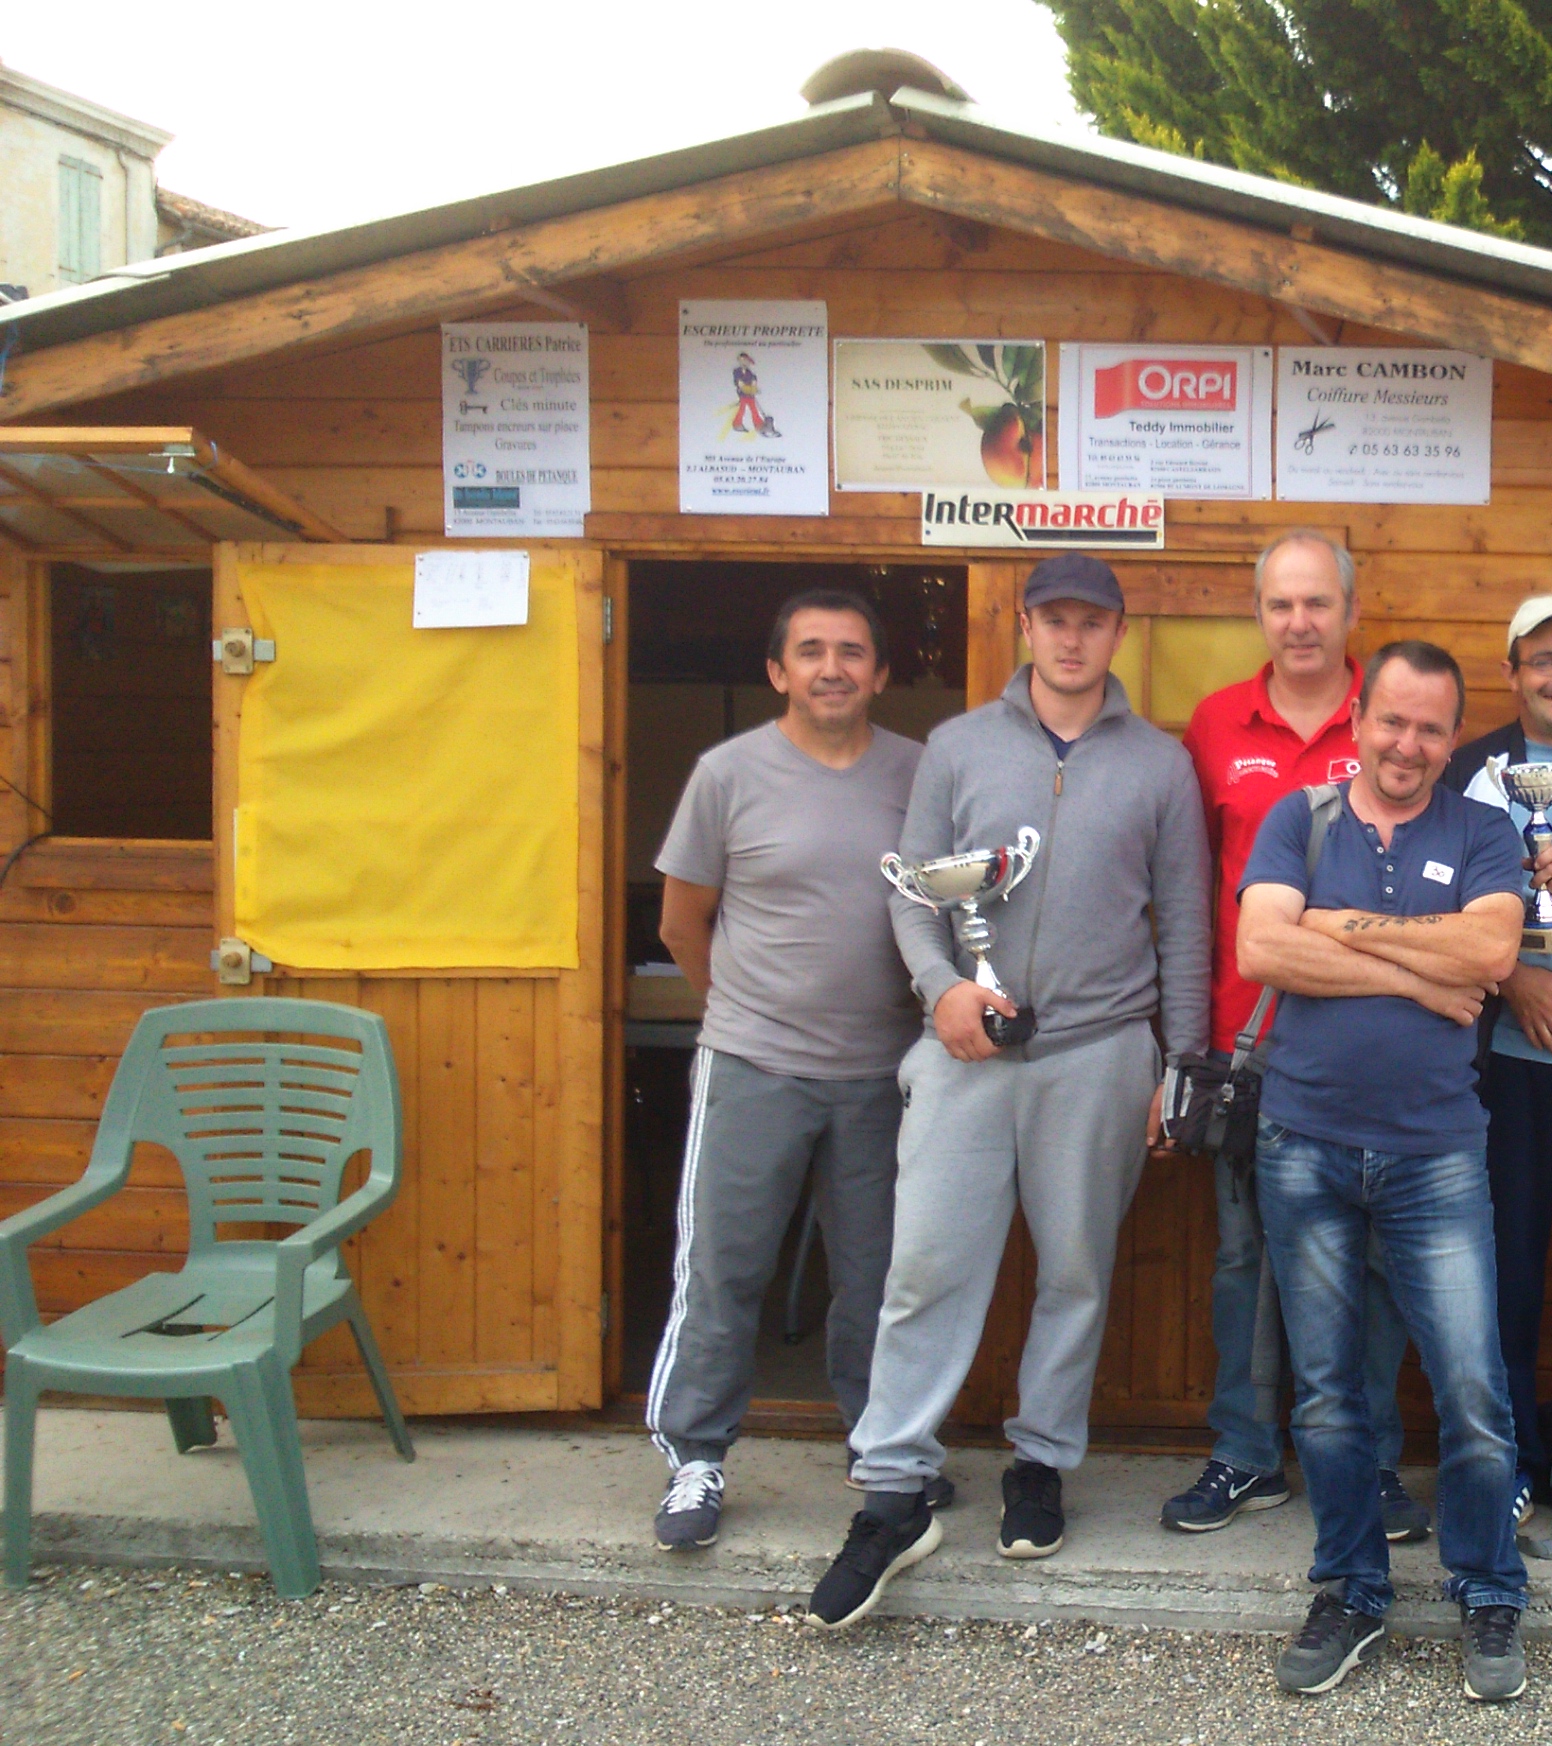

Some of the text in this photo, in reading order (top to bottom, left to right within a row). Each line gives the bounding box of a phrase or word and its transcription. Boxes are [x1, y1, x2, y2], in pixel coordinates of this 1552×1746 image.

[683, 325, 750, 337] ESCRIEUT
[545, 336, 582, 352] Patrice
[494, 367, 527, 384] Coupes
[529, 370, 538, 382] et
[1292, 361, 1466, 380] Marc CAMBON
[852, 379, 952, 391] SAS DESPRIM
[1138, 365, 1231, 400] ORPI
[1307, 387, 1449, 406] Coiffure Messieurs
[532, 400, 577, 411] minute
[454, 420, 579, 435] Tampons encreurs sur place
[1130, 421, 1234, 435] Teddy Immobilier
[495, 438, 537, 451] Gravures
[1089, 437, 1146, 449] Transactions
[1155, 439, 1193, 449] Location
[1202, 439, 1241, 449] Gérance
[1363, 444, 1461, 458] 05 63 63 35 96
[748, 465, 806, 474] MONTAUBAN
[495, 470, 525, 485] BOULES
[925, 493, 1162, 535] Intermarché
